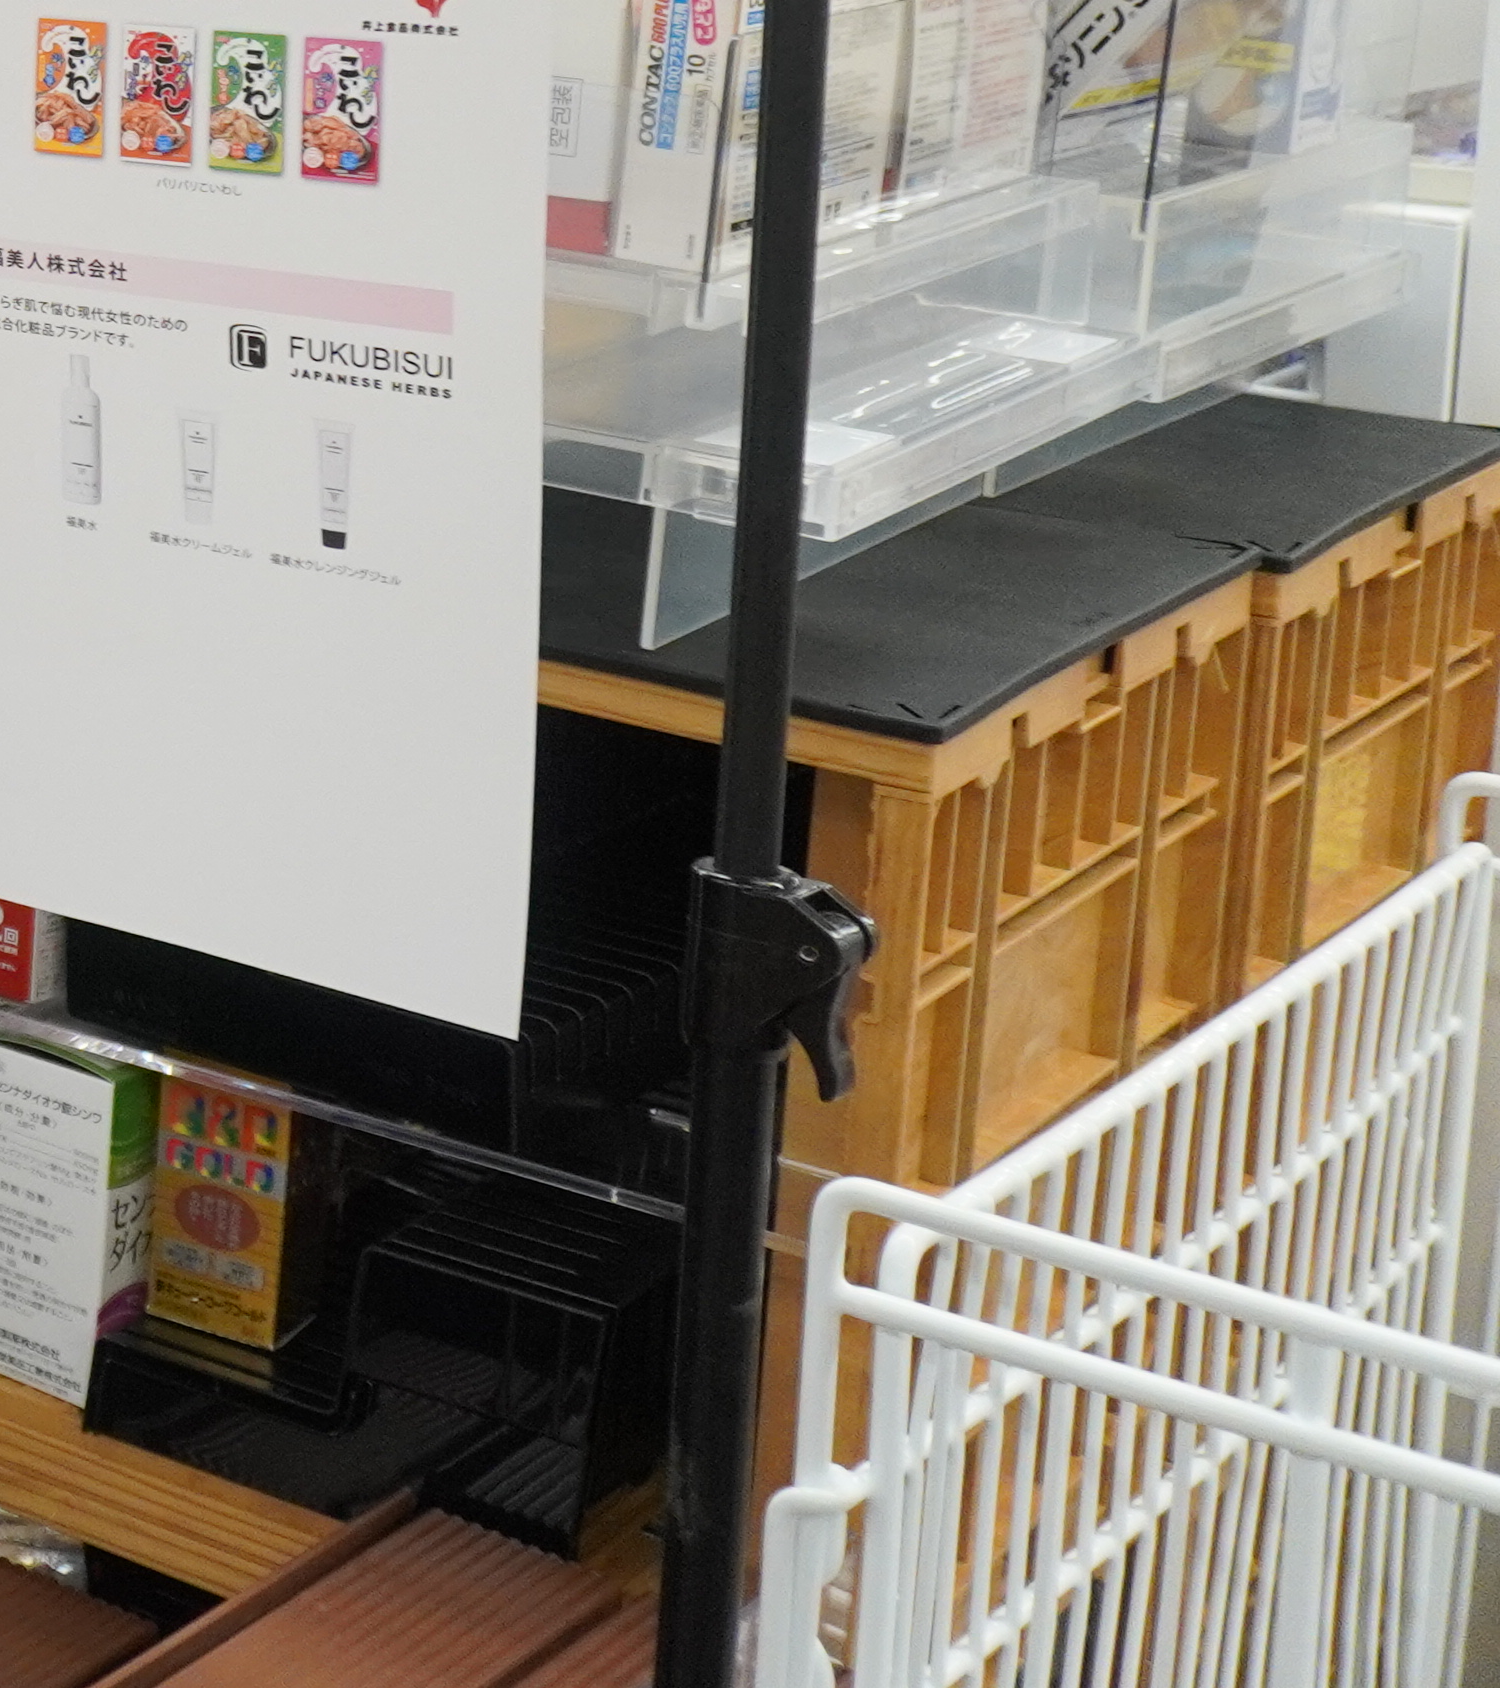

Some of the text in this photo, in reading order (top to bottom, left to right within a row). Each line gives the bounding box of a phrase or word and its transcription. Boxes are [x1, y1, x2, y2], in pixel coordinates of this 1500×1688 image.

[687, 53, 706, 77] 10
[638, 44, 665, 147] CONTAC
[288, 334, 454, 381] FUKUBISUI
[290, 367, 454, 400] JAPANESE HERBS
